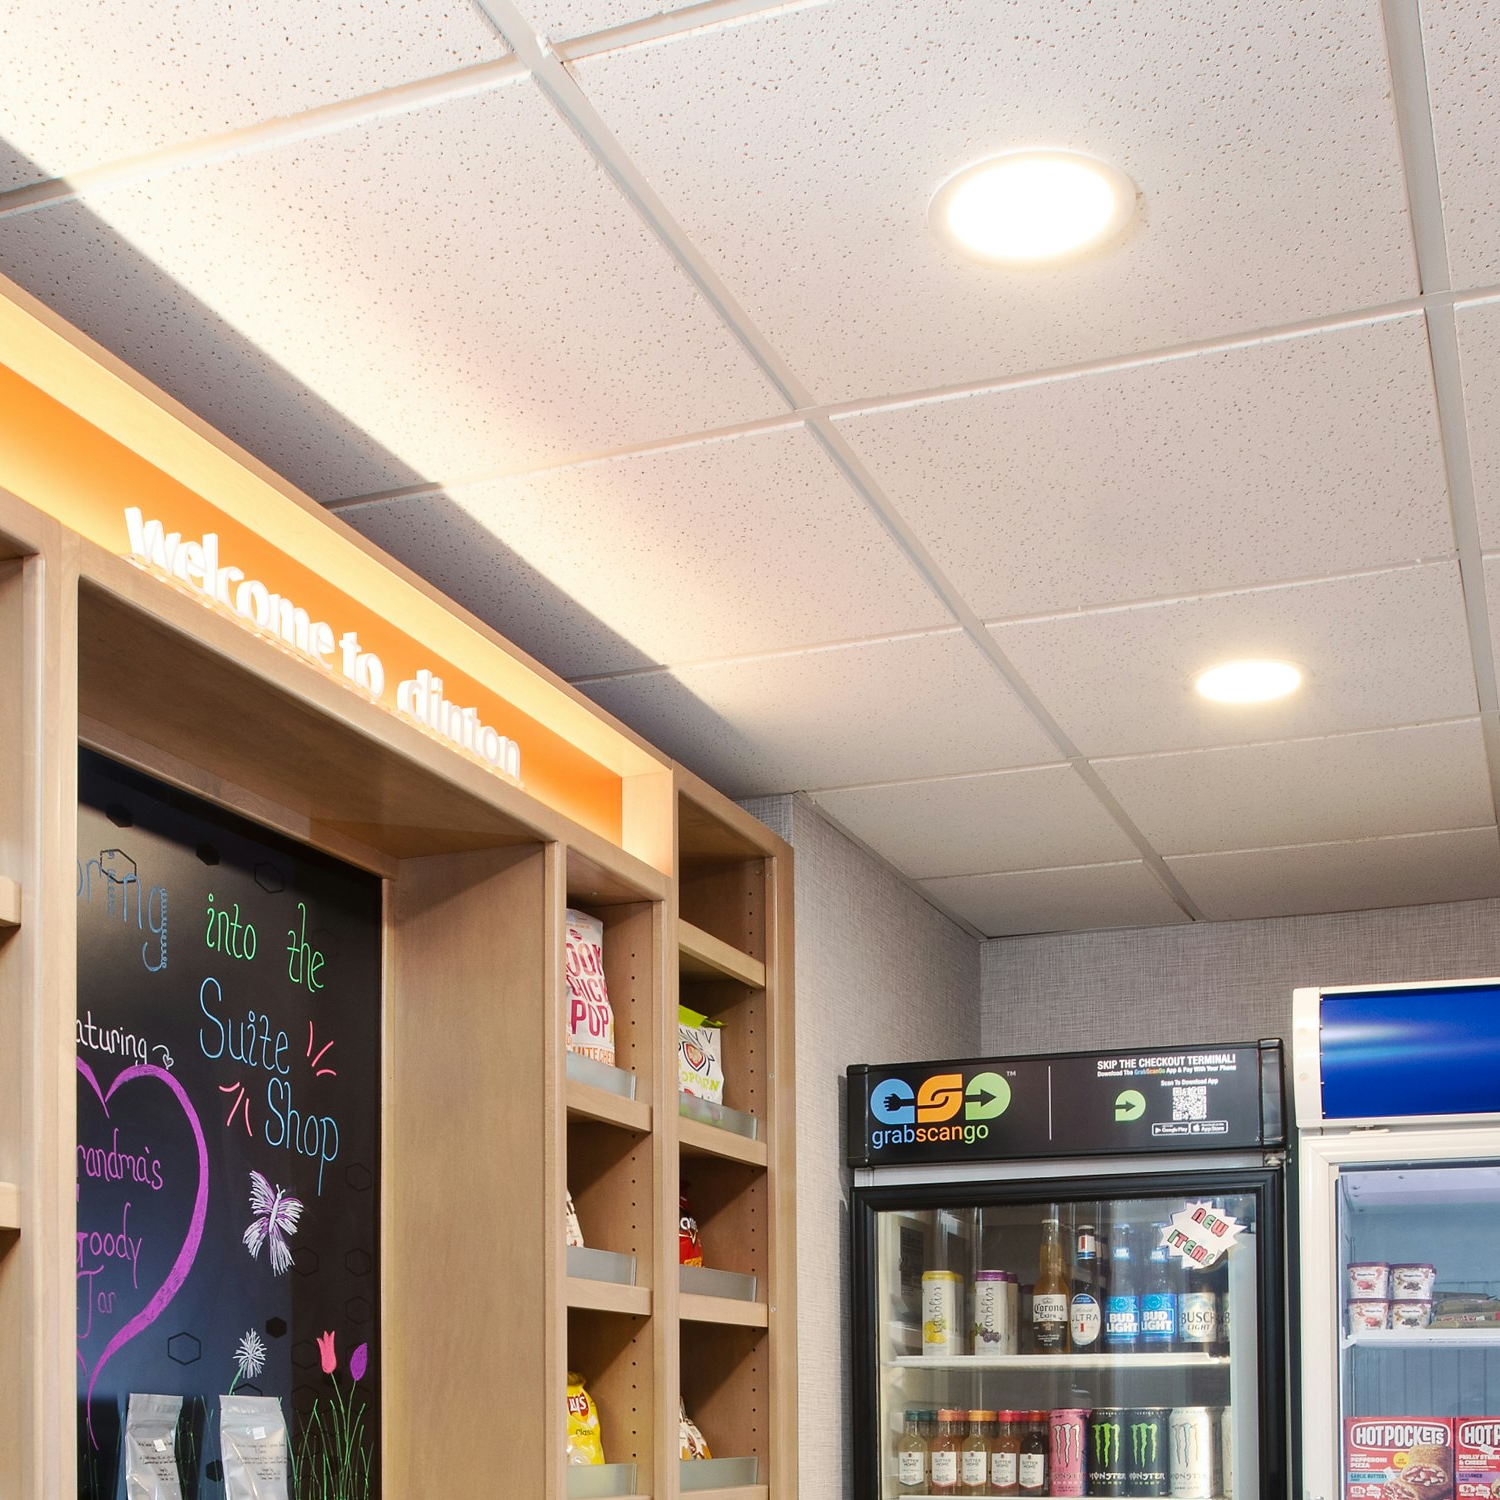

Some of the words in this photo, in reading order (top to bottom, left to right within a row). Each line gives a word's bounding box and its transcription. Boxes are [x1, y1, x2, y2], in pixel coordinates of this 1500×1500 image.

[339, 632, 385, 699] to
[207, 893, 257, 960] into
[287, 903, 324, 992] the
[200, 977, 290, 1074] Suite
[571, 1000, 608, 1038] POP
[1097, 1061, 1117, 1070] SKIP
[1119, 1059, 1136, 1068] THE
[1139, 1056, 1185, 1068] CHECKOUT
[1187, 1054, 1236, 1065] TERMINAL!
[266, 1078, 338, 1197] Shop
[871, 1124, 989, 1150] grabscango
[77, 1128, 163, 1190] randma's
[1191, 1207, 1230, 1238] NEW
[1034, 1303, 1064, 1314] Corona
[1072, 1313, 1098, 1322] ULTRA
[1109, 1313, 1134, 1323] BUD
[1143, 1311, 1168, 1320] BUD
[1107, 1323, 1138, 1333] LIGHT
[1141, 1320, 1172, 1331] LIGHT
[1356, 1424, 1382, 1447] HOT
[1384, 1424, 1445, 1447] POCKETS
[1464, 1424, 1491, 1447] HOT
